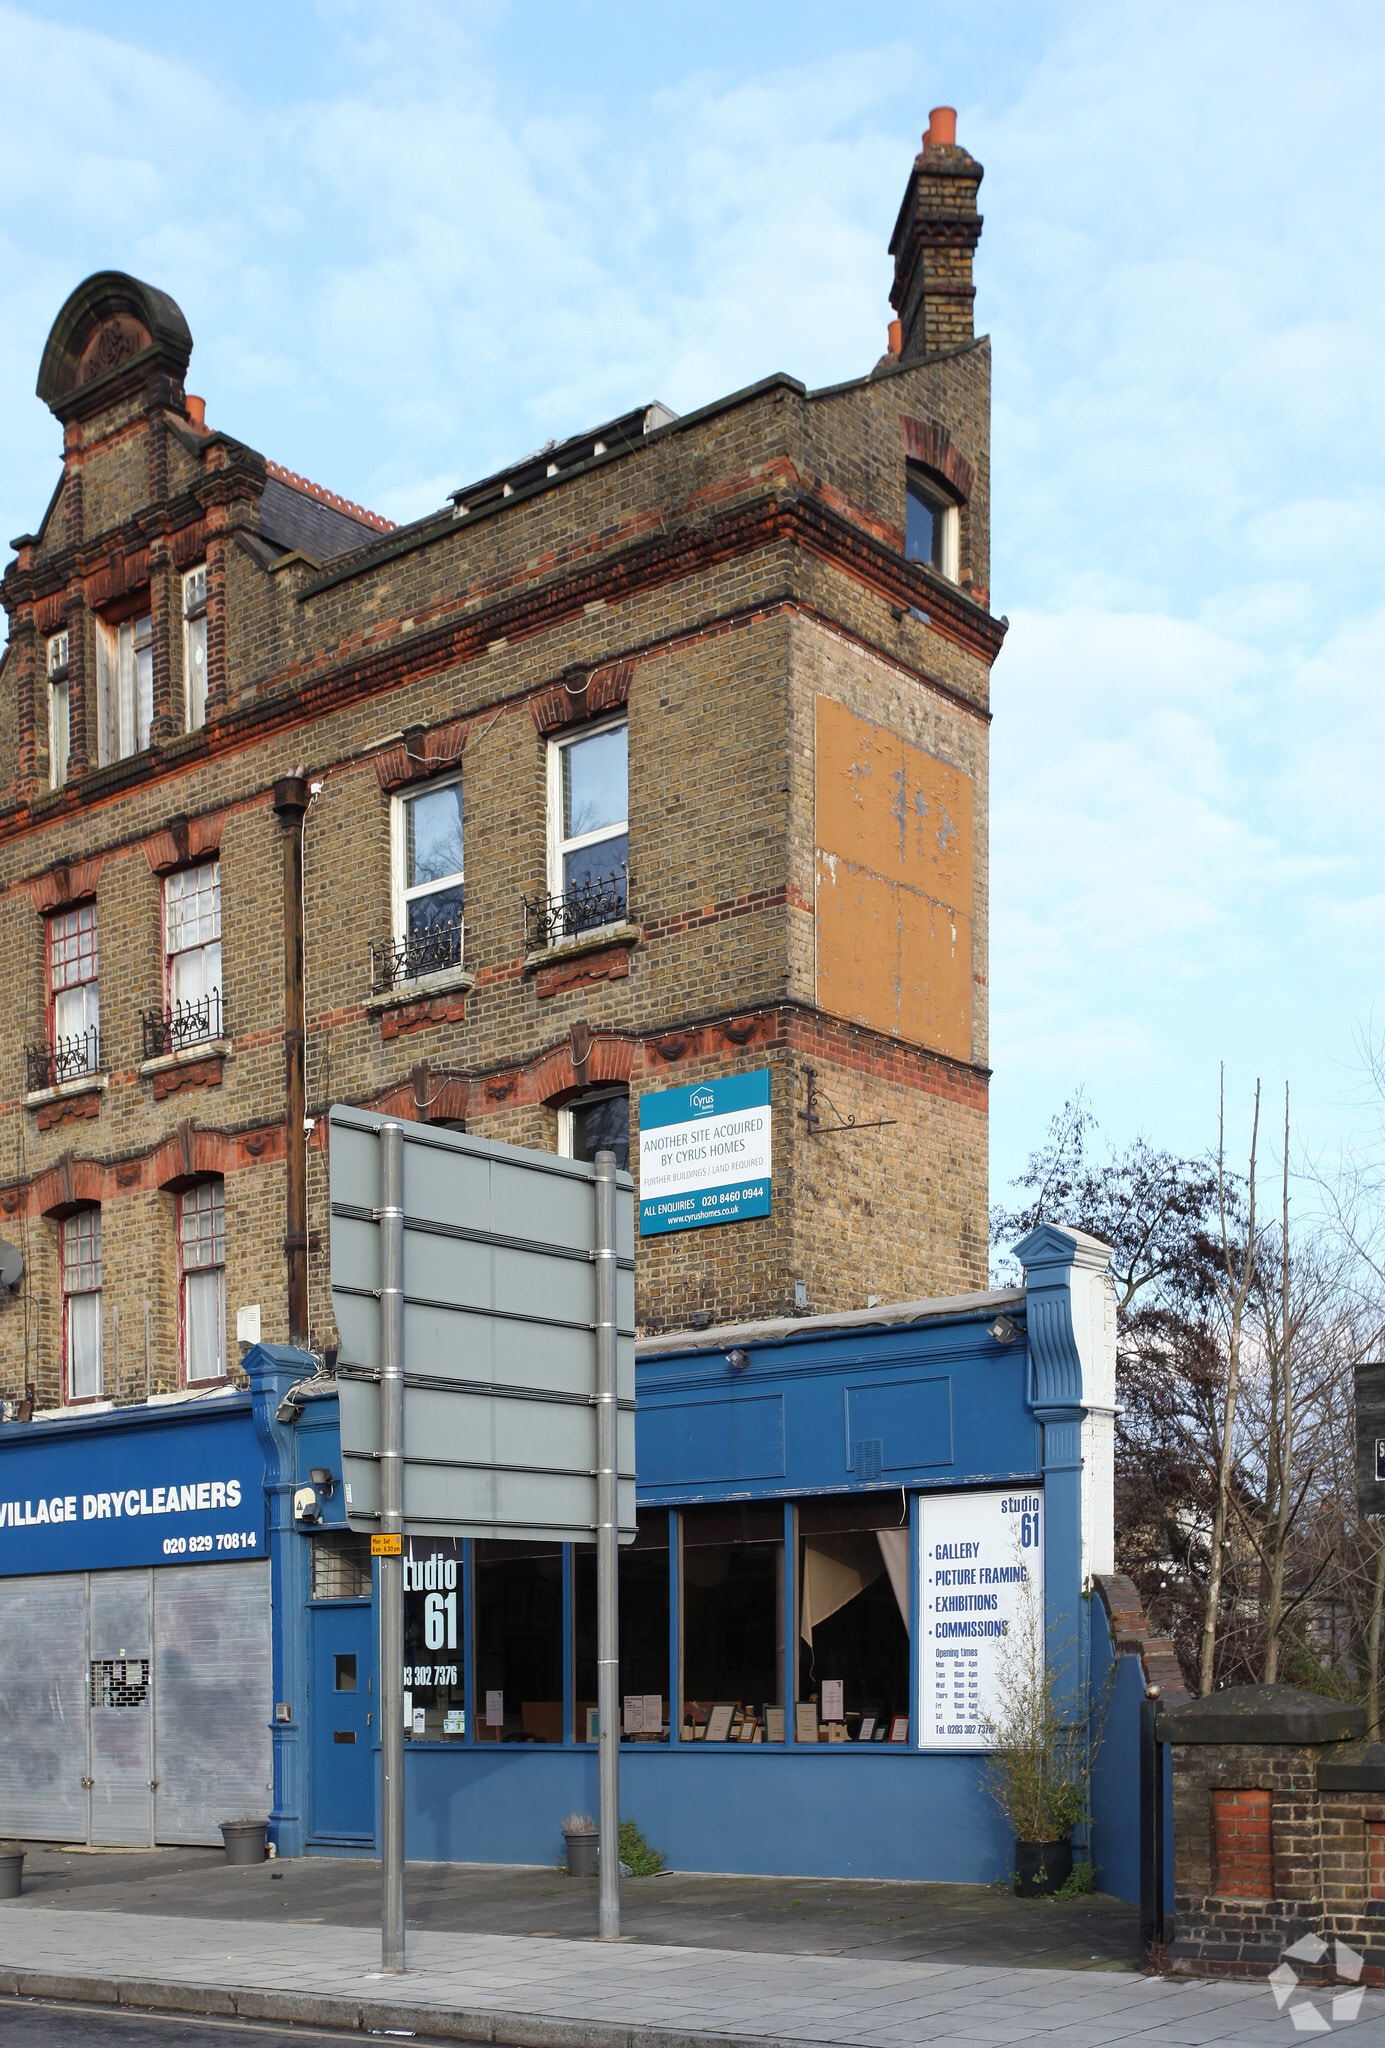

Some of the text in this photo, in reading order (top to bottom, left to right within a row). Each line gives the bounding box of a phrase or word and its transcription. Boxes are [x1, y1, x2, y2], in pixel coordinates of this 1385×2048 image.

[693, 1095, 713, 1107] Cyrus
[644, 1118, 763, 1153] ANOTHER SITE ACQUIRED
[661, 1138, 746, 1166] BY CYRUS HOMES
[643, 1175, 671, 1187] FURTHER
[673, 1168, 706, 1182] BUILDINGS
[712, 1163, 730, 1175] LAND
[731, 1157, 764, 1170] REQUIRED
[643, 1187, 764, 1217] ALL ENQUIRIES 020 8460 0944
[668, 1204, 739, 1225] www.cyrushomes.co.uk
[83, 1479, 242, 1520] DRYCLEANERS
[1001, 1495, 1039, 1513] studio
[1021, 1513, 1039, 1548] 61
[163, 1532, 256, 1555] 020 829 70814
[935, 1542, 980, 1560] GALLERY
[403, 1553, 457, 1591] tudio
[935, 1566, 1027, 1586] PICTURE FRAMING
[935, 1594, 998, 1612] EXHIBITIONS
[425, 1592, 457, 1650] 61
[935, 1620, 1008, 1639] COMMISSIONS
[936, 1647, 978, 1659] Opening times
[414, 1666, 432, 1686] 302
[434, 1665, 458, 1686] 7376
[968, 1670, 978, 1678] 4pm
[936, 1724, 993, 1734] Tel. 0203 302 7376
